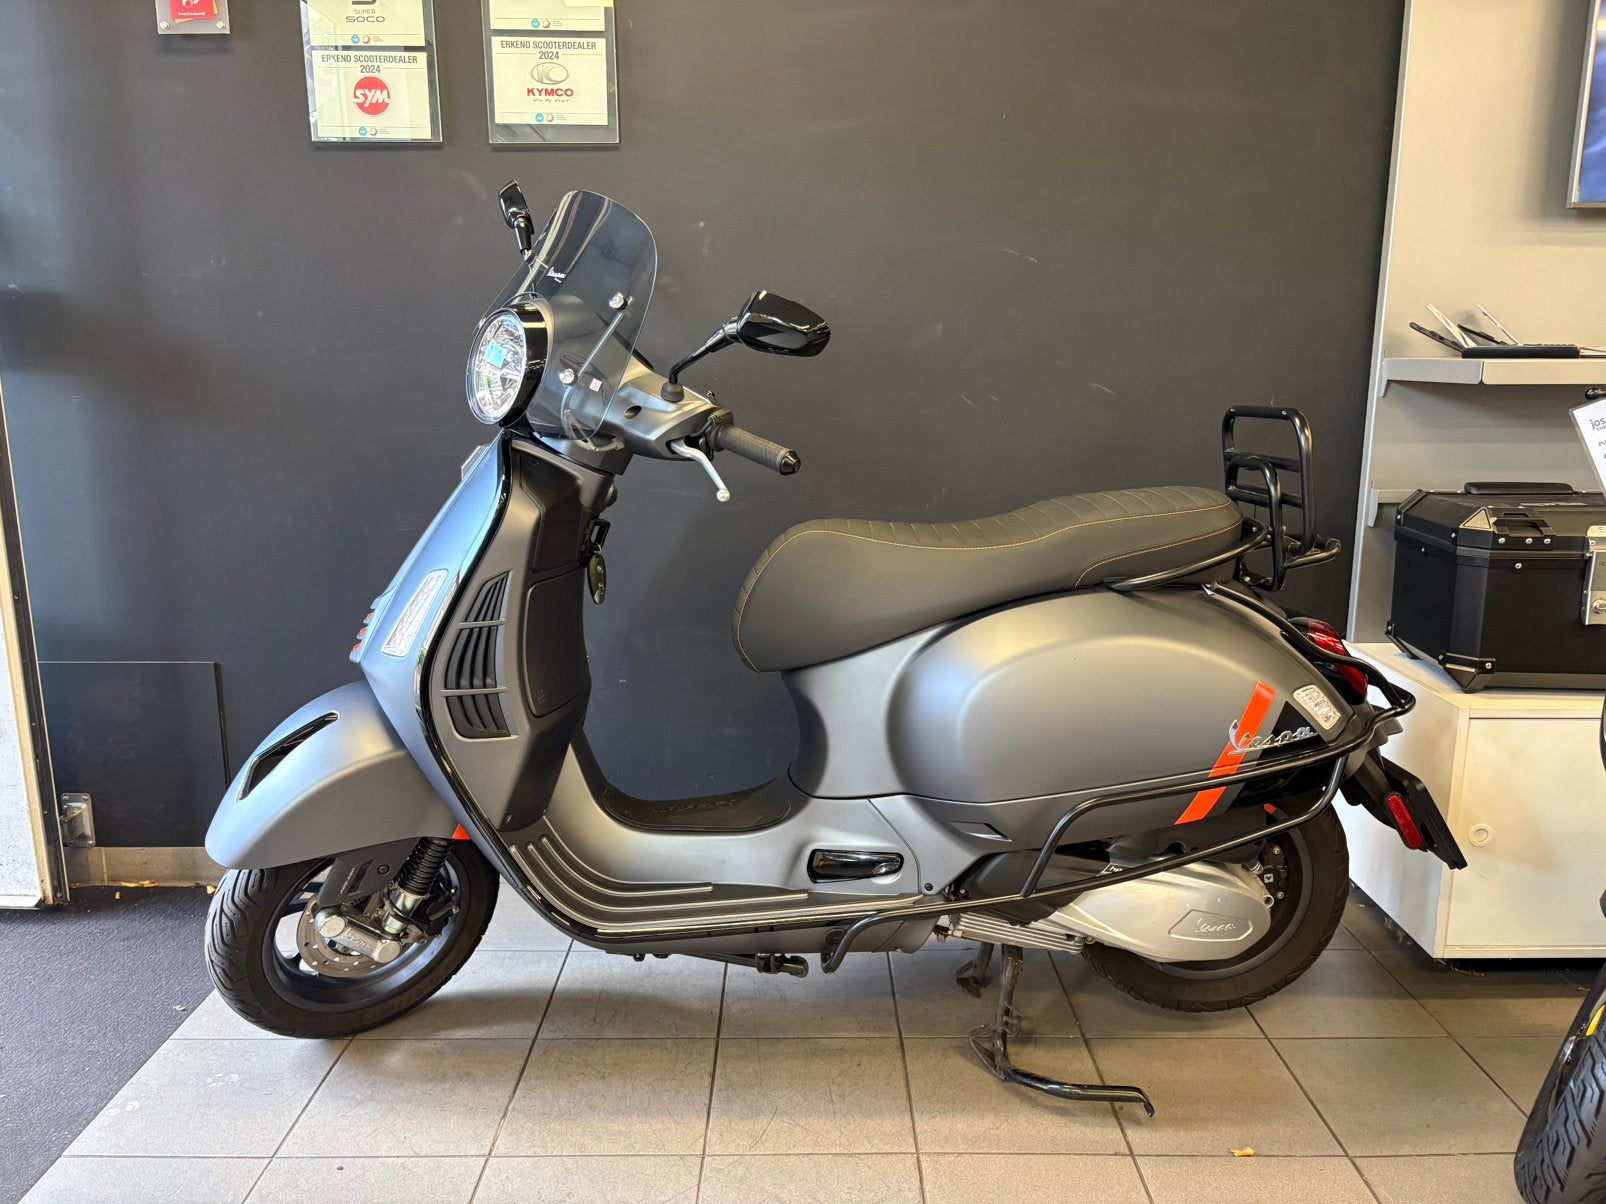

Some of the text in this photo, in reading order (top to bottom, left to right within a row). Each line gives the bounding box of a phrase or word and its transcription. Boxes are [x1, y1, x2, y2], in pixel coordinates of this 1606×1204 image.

[501, 40, 597, 50] ERKEND SCOOTERDEALER
[321, 54, 418, 64] ERKEND SCOOTERDEALER
[539, 51, 560, 60] 2024
[360, 65, 381, 74] 2024
[527, 88, 574, 97] KYMCO
[353, 89, 391, 108] SYM
[1228, 719, 1319, 756] Vespa
